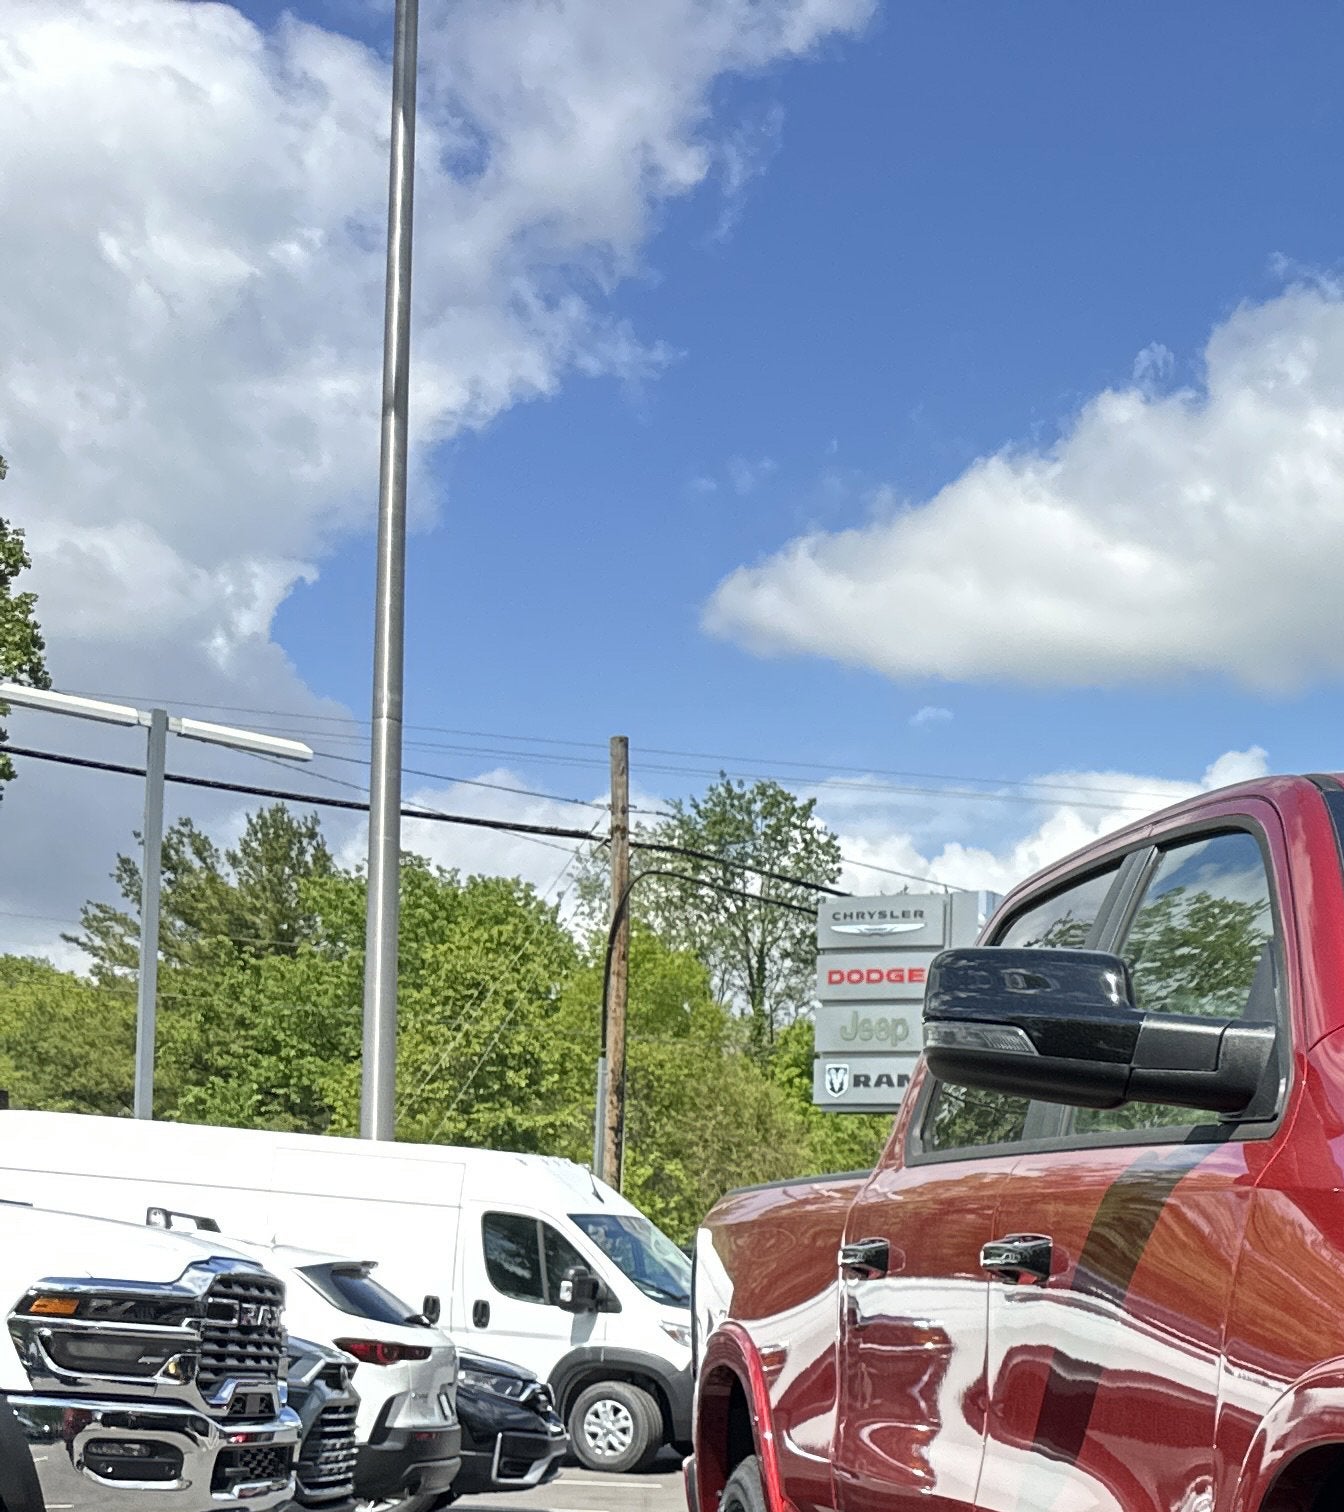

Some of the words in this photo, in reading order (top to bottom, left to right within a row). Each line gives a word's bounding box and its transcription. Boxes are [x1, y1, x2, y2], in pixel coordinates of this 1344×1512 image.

[831, 909, 925, 922] CHRYSLER
[827, 967, 926, 985] DODGE
[839, 1011, 909, 1047] Jeep
